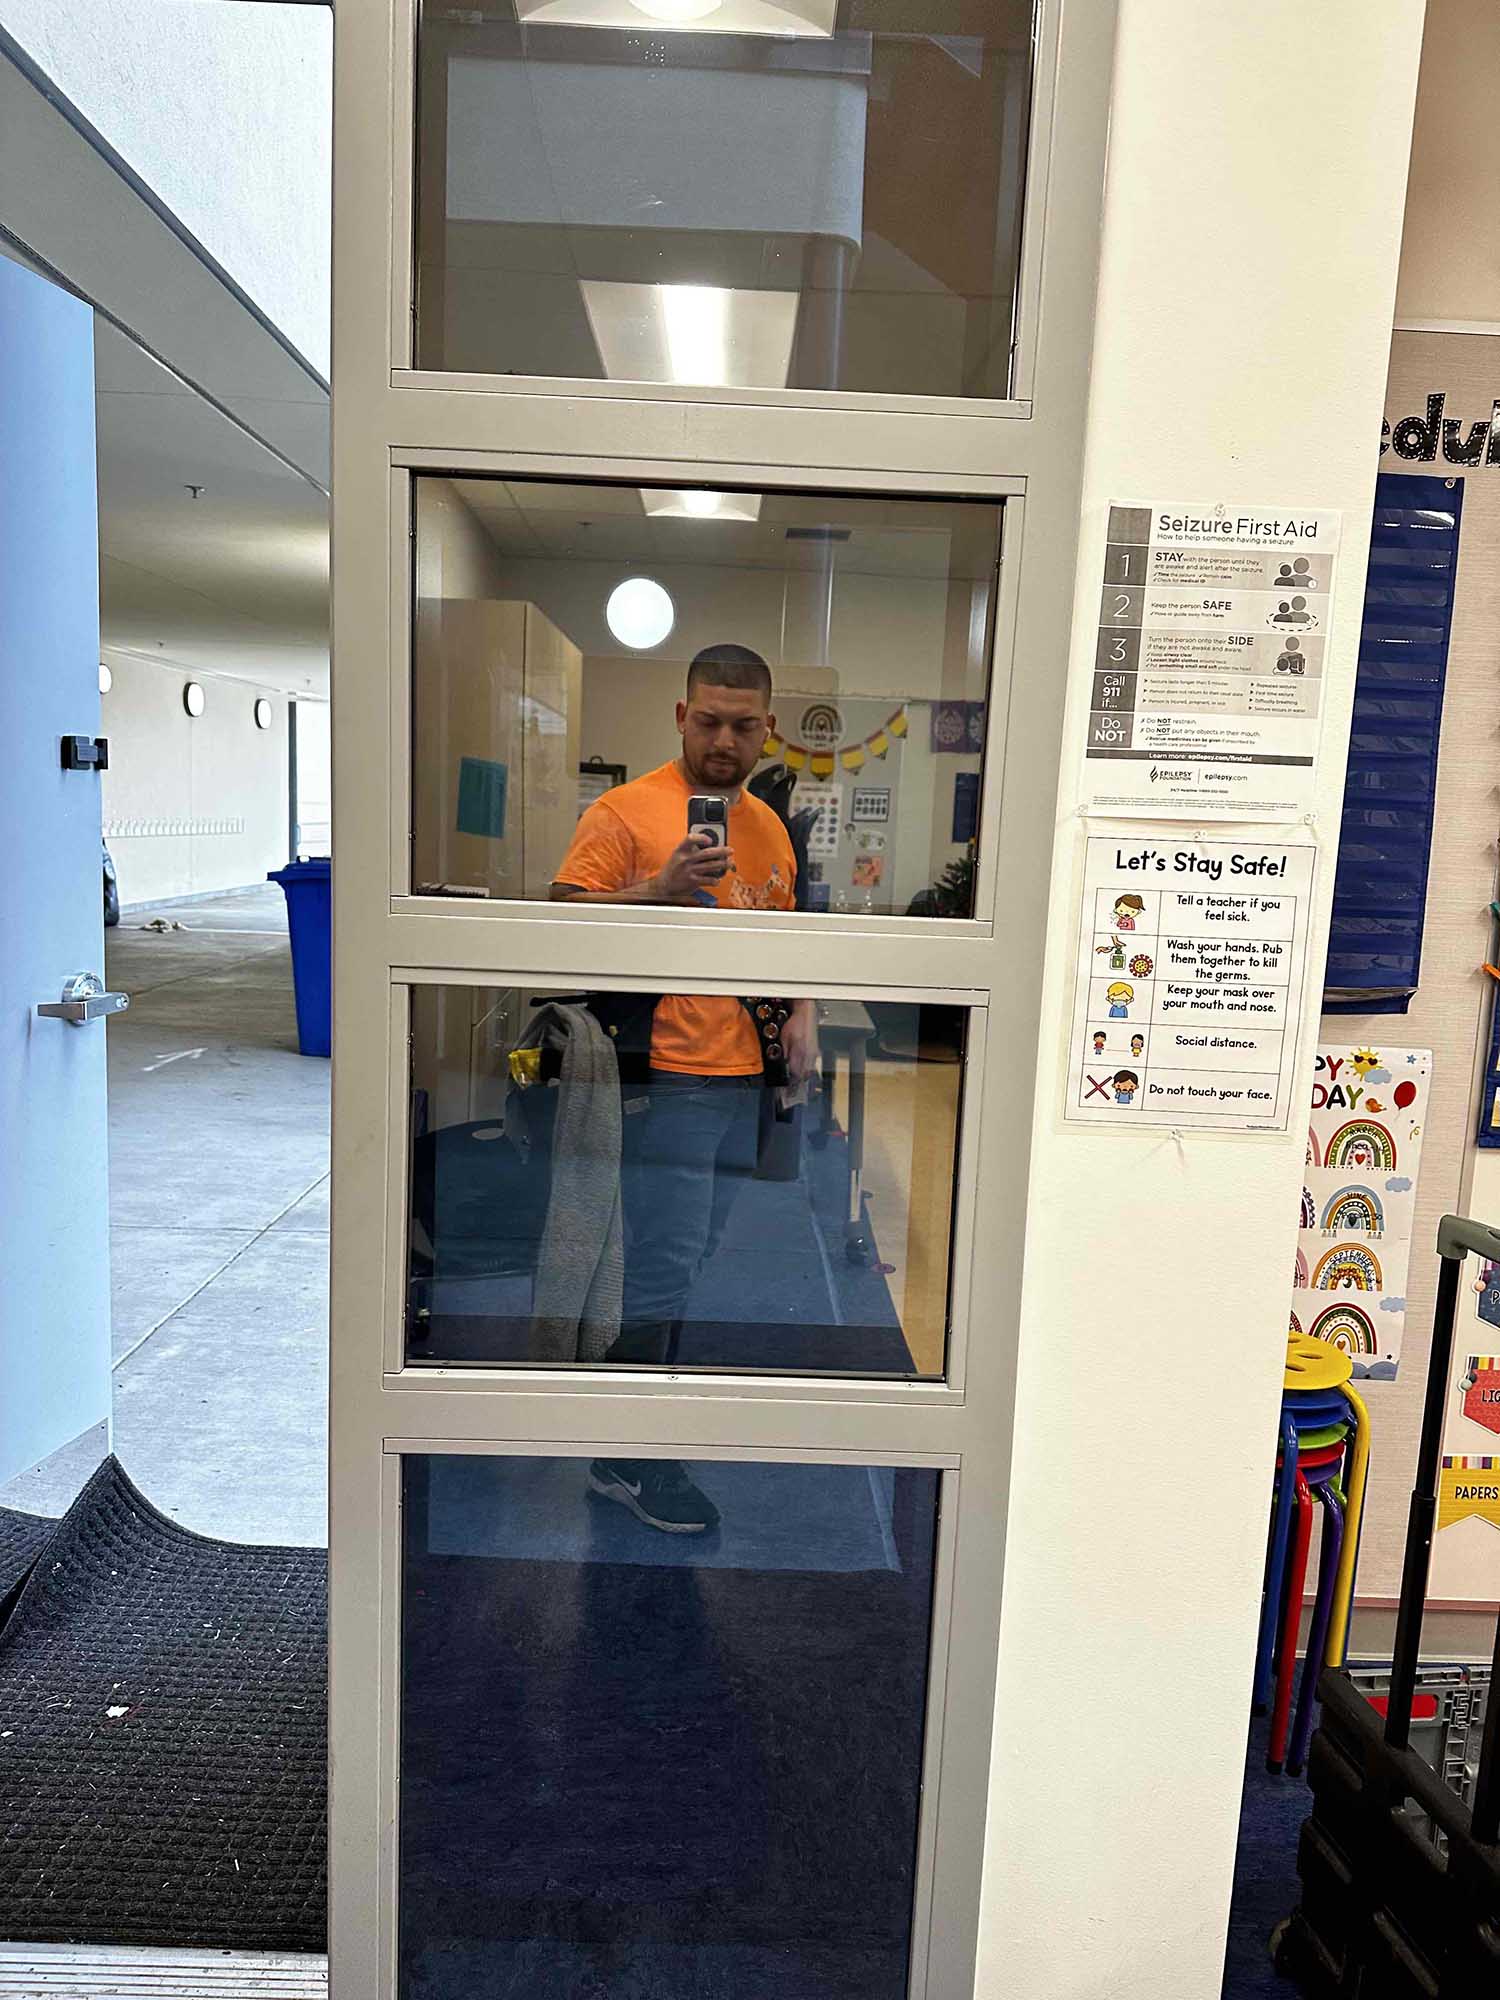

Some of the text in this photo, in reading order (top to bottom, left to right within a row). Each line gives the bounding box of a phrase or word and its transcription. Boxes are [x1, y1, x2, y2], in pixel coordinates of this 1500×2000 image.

[1159, 515, 1318, 538] Seizure First Aid
[1236, 536, 1260, 545] having
[1155, 552, 1184, 562] STAY
[1121, 554, 1130, 576] 1
[1113, 595, 1130, 617] 2
[1203, 600, 1232, 610] SAFE
[1228, 636, 1254, 646] SIDE
[1110, 638, 1127, 661] 3
[1104, 675, 1125, 686] Call
[1102, 687, 1121, 697] 911
[1101, 698, 1118, 708] if...
[1101, 717, 1121, 729] Do
[1095, 730, 1126, 742] NOT
[1188, 754, 1252, 762] epilepsy.com/firstaid
[1116, 850, 1287, 880] Let's Stay Safe!
[1177, 895, 1194, 905] Tell
[1207, 896, 1246, 908] teacher
[1250, 898, 1259, 908] if
[1261, 901, 1280, 912] you
[1205, 910, 1250, 922] feel sick.
[1167, 939, 1283, 954] Wash your hands. Rub
[1171, 953, 1277, 968] them together to kill
[1195, 968, 1250, 982] the germs.
[1168, 984, 1275, 998] Keep your mask over
[1162, 1000, 1277, 1012] your mouth and nose.
[1175, 1035, 1257, 1049] Social distance.
[1150, 1084, 1272, 1100] Do not touch your face.
[1311, 1083, 1364, 1110] DAY
[1349, 1126, 1378, 1138] MARCH
[1346, 1193, 1368, 1201] JUNE
[1329, 1250, 1374, 1267] SEPTEMBER
[1455, 1486, 1499, 1500] PAPERS
